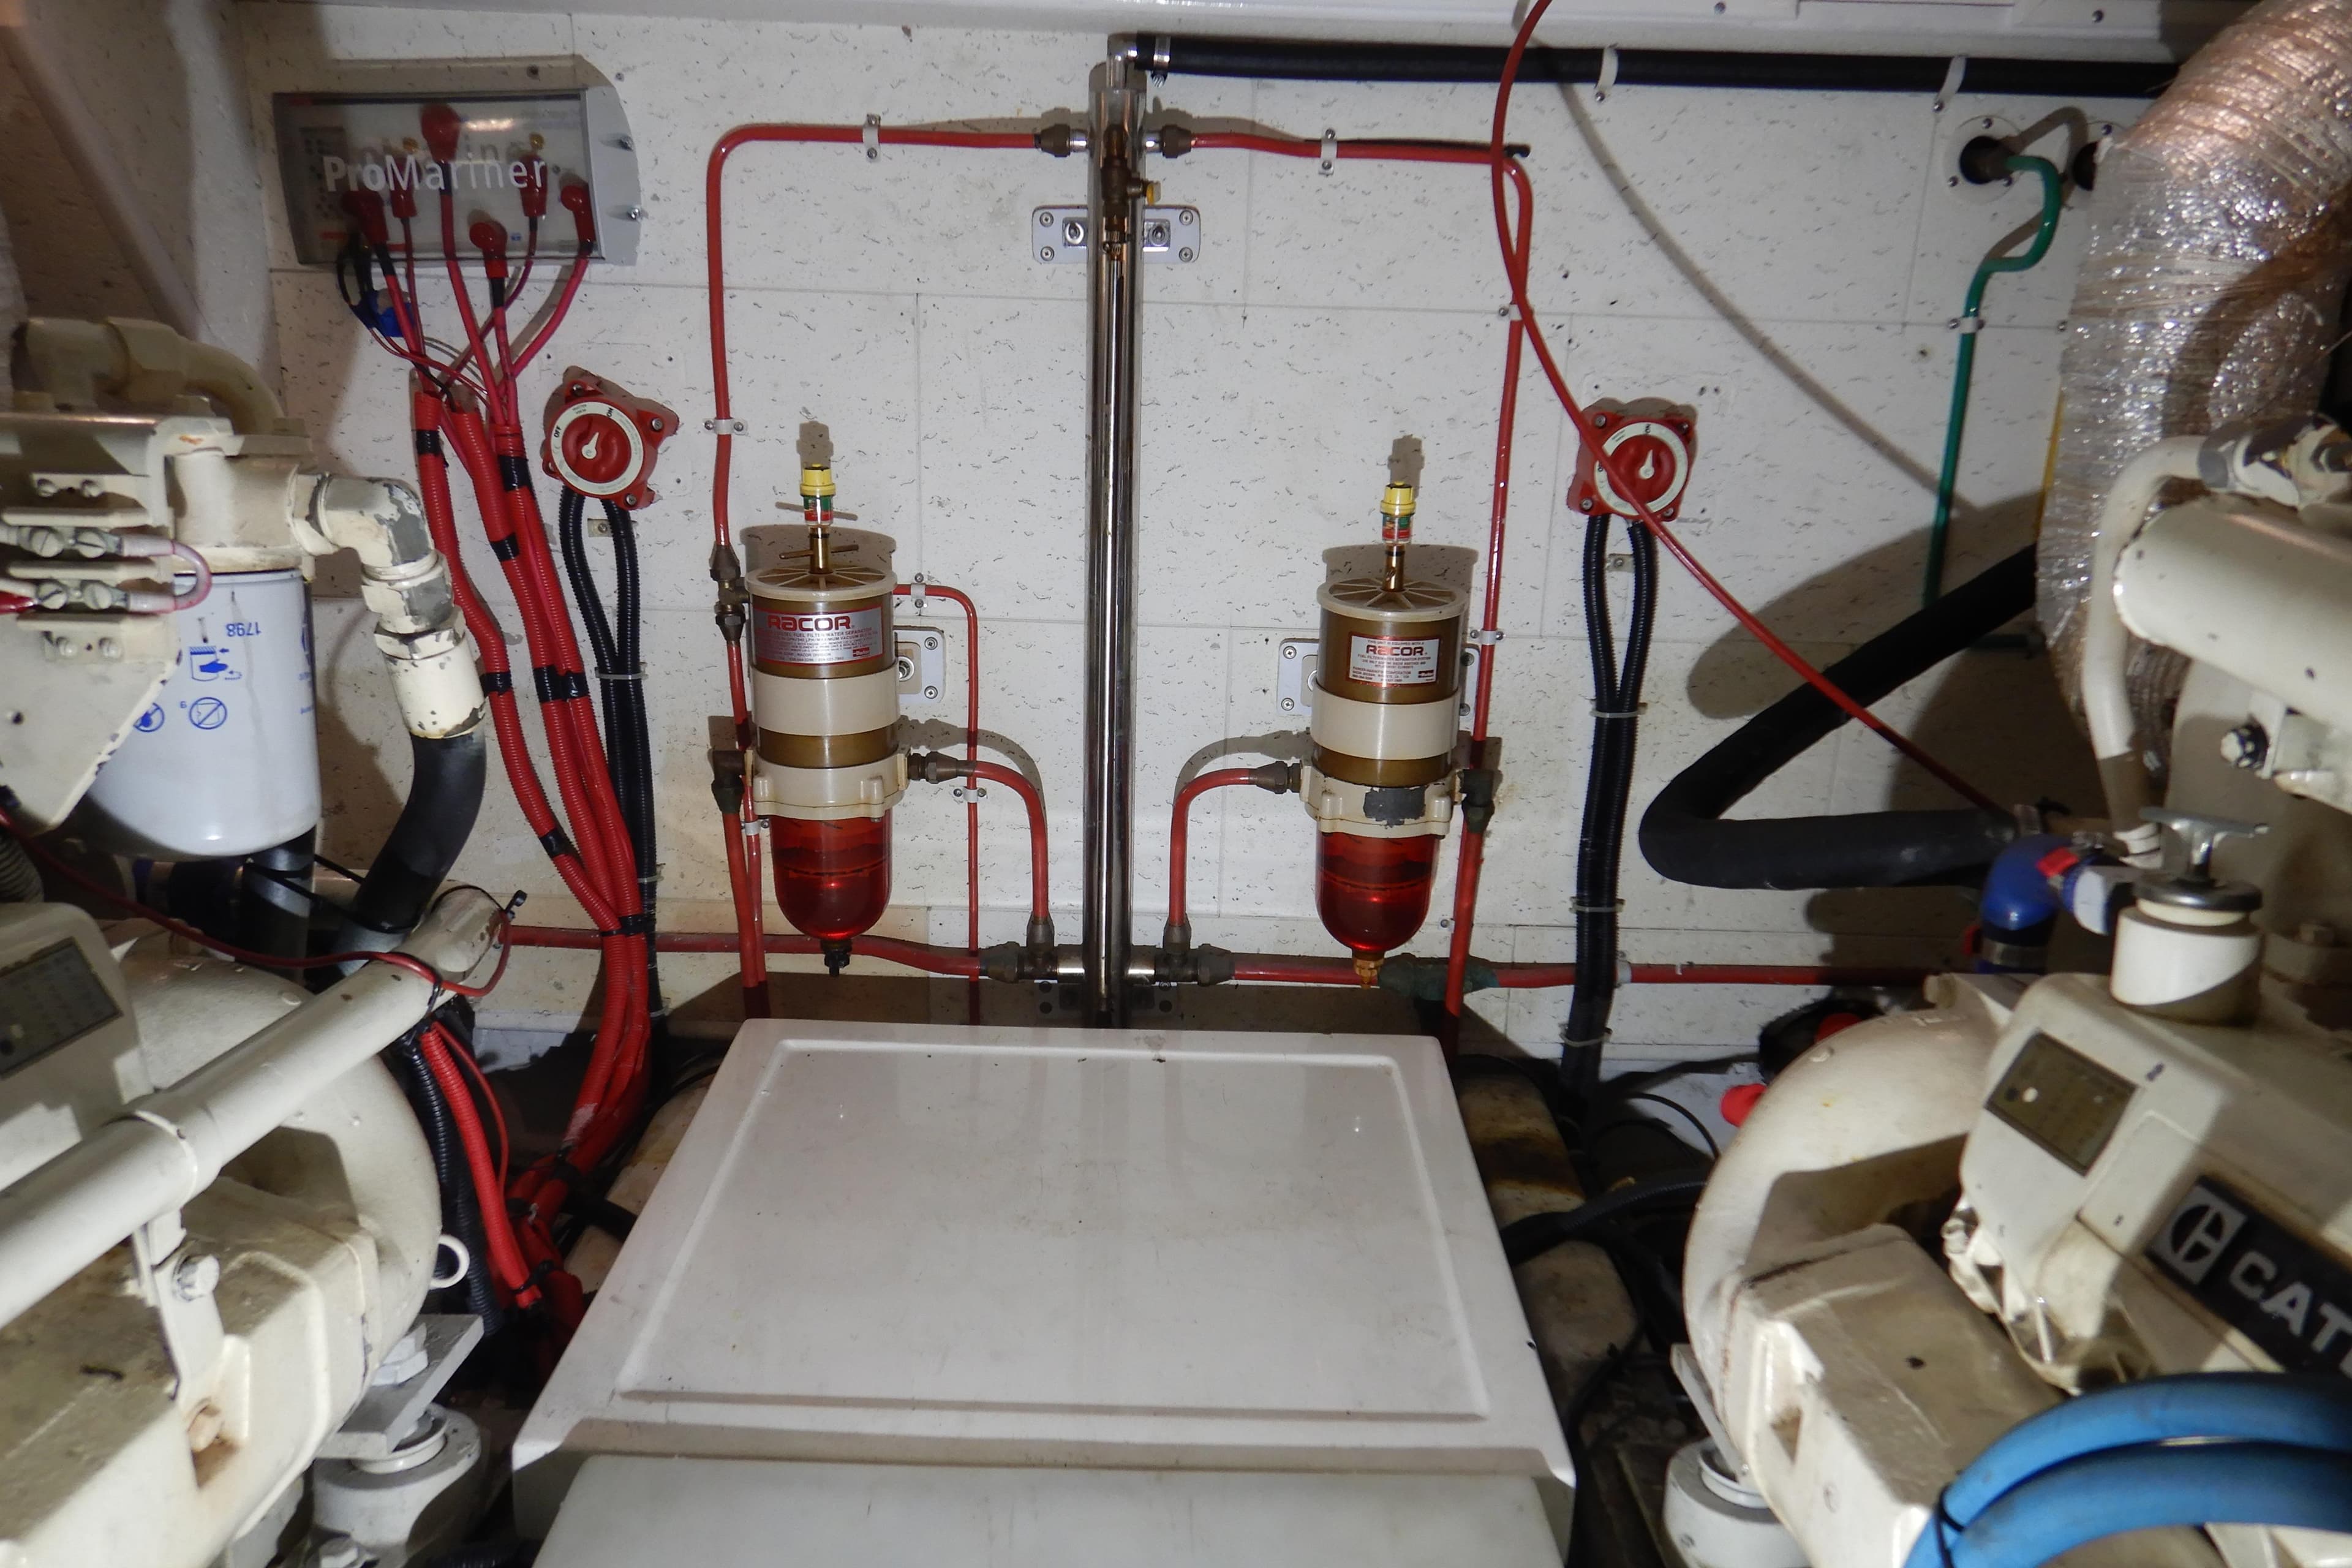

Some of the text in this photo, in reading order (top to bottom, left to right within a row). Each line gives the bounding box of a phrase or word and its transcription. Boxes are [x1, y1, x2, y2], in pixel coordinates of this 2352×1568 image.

[322, 154, 548, 192] ProMariner
[606, 407, 614, 417] ON
[553, 426, 562, 438] OFF
[225, 622, 262, 637] 1798
